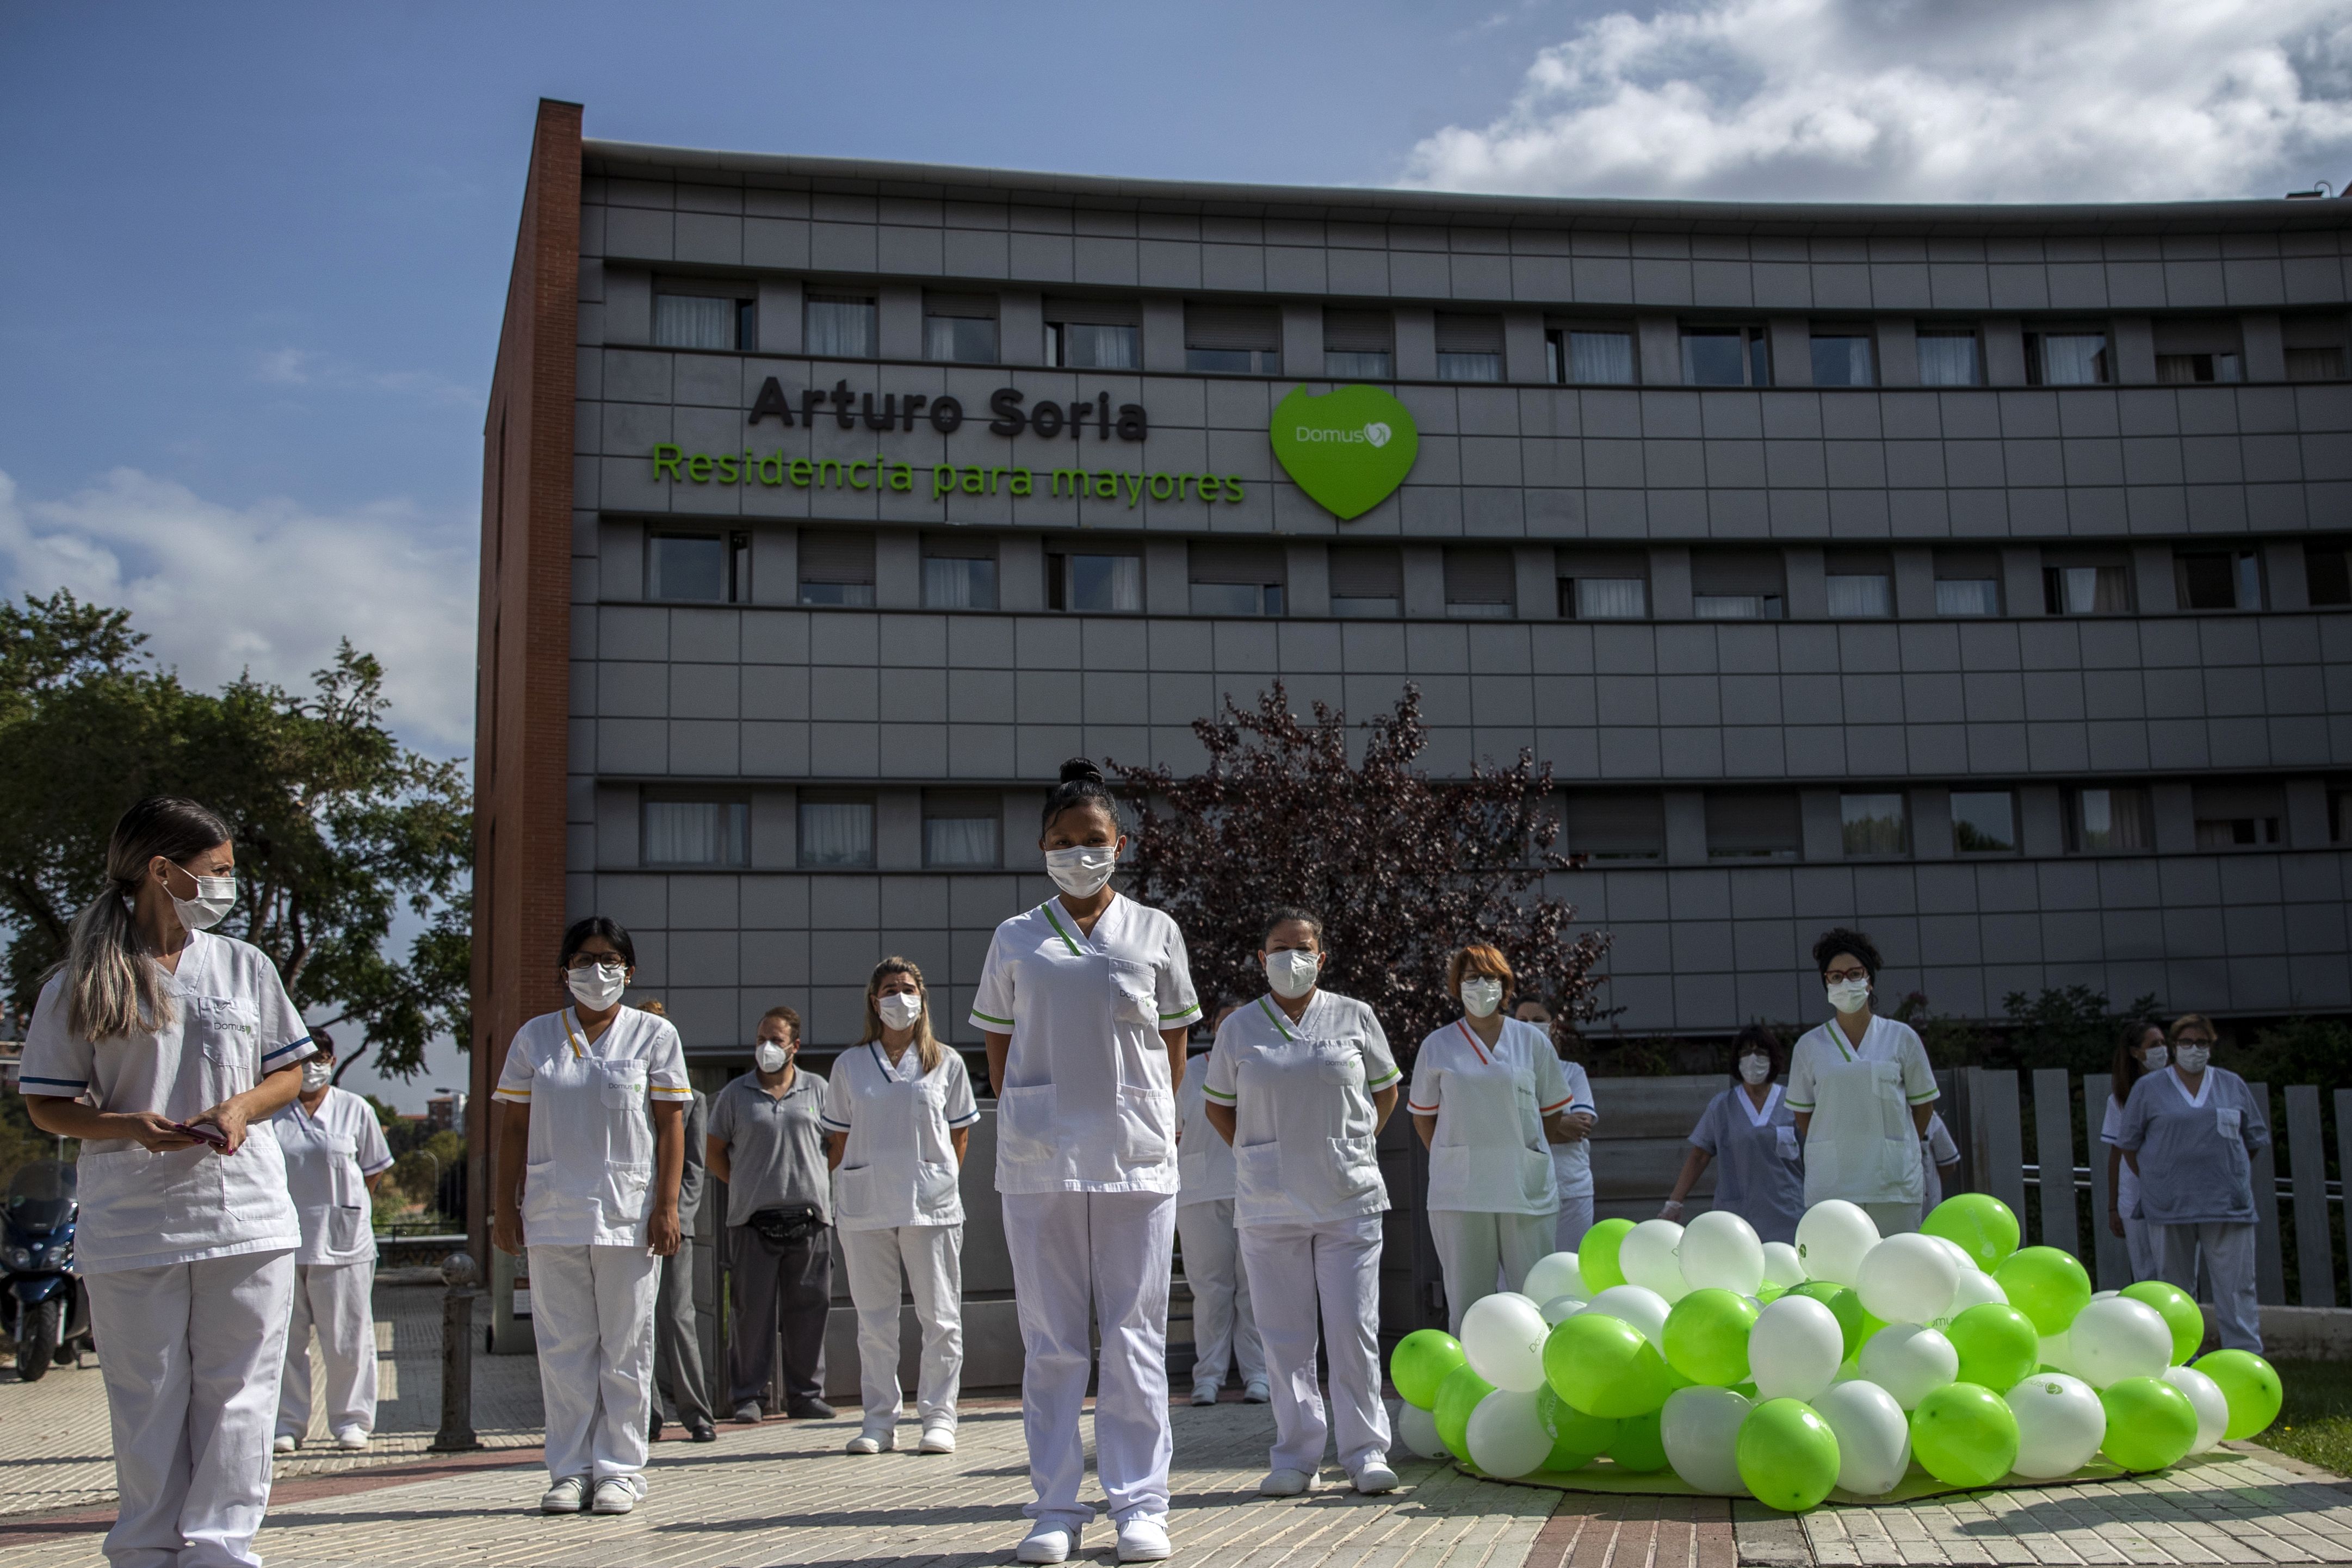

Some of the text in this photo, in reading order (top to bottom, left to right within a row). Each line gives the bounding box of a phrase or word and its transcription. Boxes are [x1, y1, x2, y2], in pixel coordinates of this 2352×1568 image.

[748, 377, 1147, 441] Arturo Soria
[1296, 426, 1365, 443] Domus
[654, 443, 1245, 508] Residencia para mayores
[214, 1022, 245, 1032] Domus
